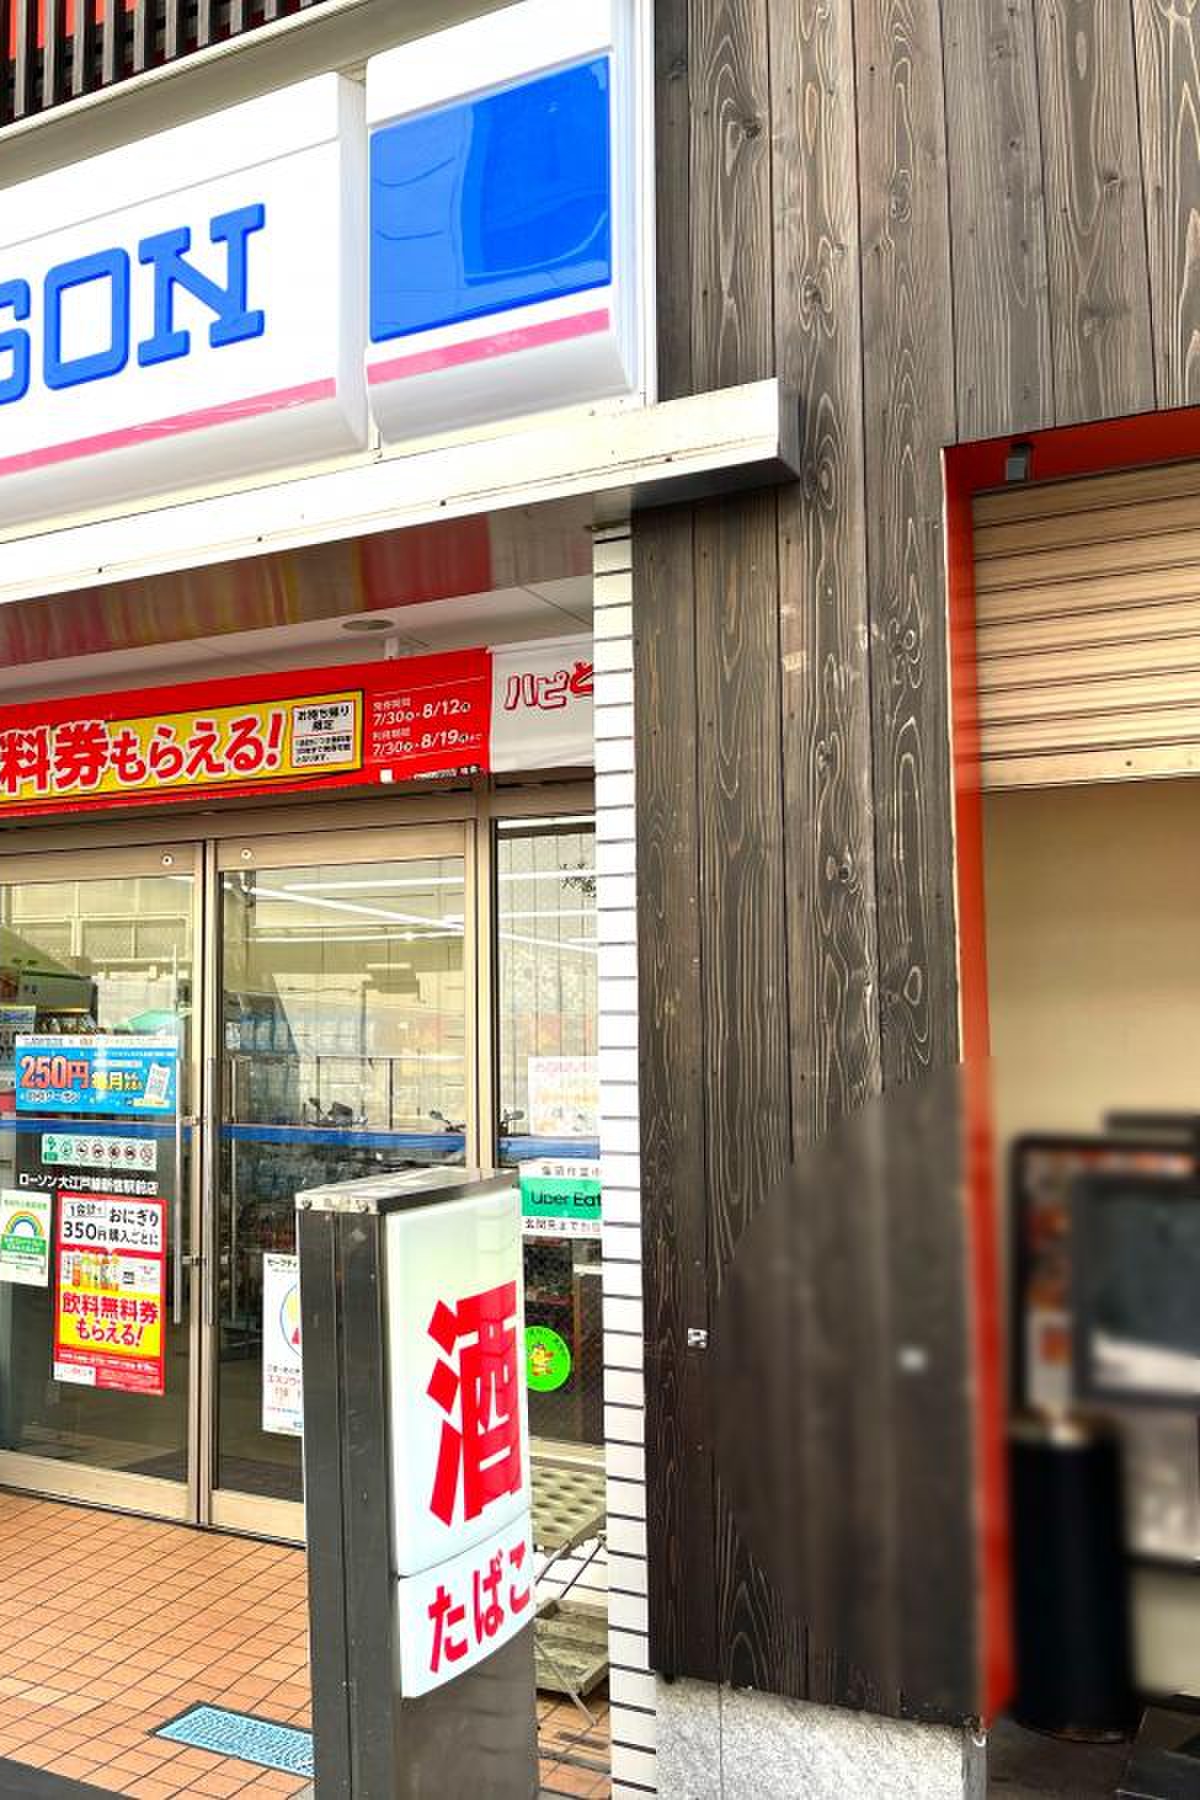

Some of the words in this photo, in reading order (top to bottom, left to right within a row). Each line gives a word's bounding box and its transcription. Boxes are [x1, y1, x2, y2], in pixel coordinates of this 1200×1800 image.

[20, 1055, 89, 1089] 250円
[531, 1190, 569, 1205] Uber
[63, 1220, 159, 1246] 350円購入ごとに
[108, 1206, 159, 1227] おにぎり
[62, 1291, 159, 1324] 飲料無料券
[426, 1280, 521, 1528] 酒
[426, 1540, 533, 1673] たばこ
